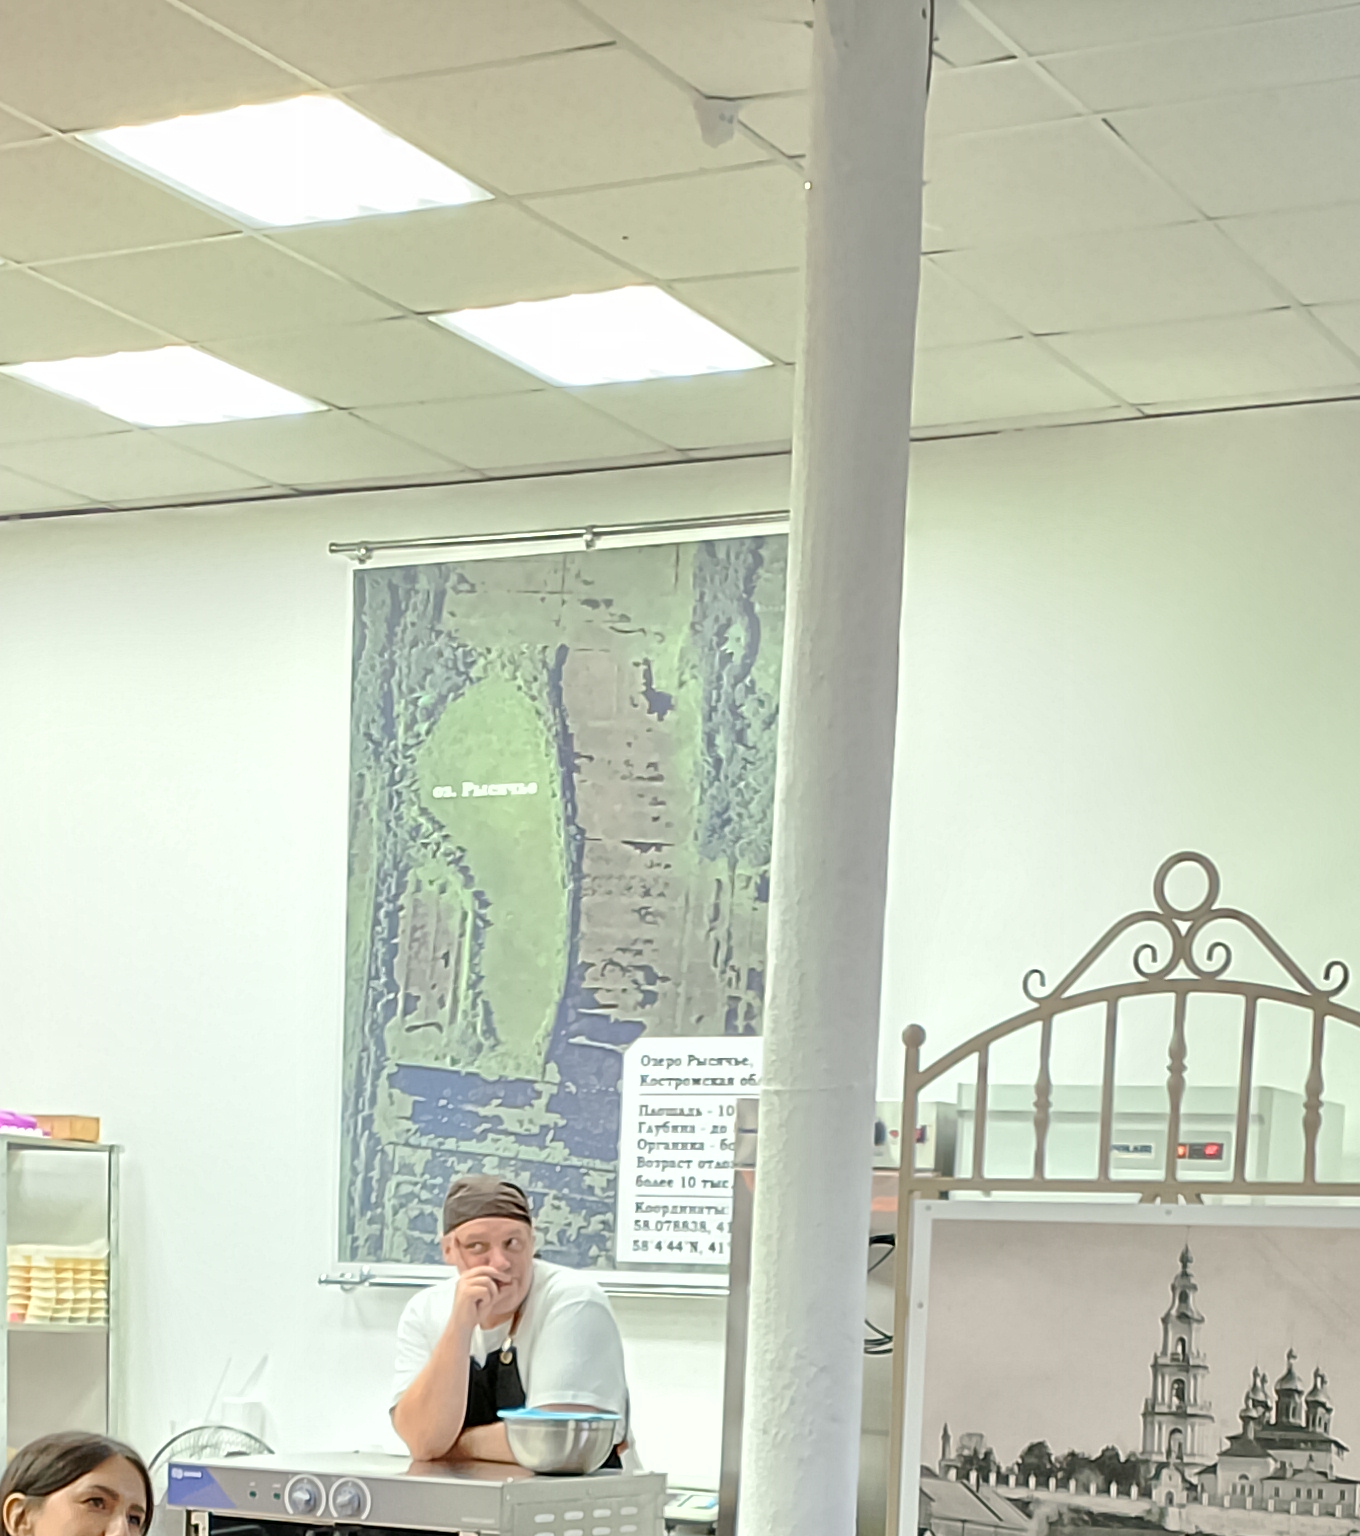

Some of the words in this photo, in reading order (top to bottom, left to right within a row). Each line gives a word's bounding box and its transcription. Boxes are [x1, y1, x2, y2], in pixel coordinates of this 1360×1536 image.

[641, 1054, 682, 1069] Озеро
[640, 1074, 735, 1090] Костромская
[636, 1156, 693, 1172] Возраст
[635, 1175, 674, 1188] более
[681, 1176, 696, 1188] 10
